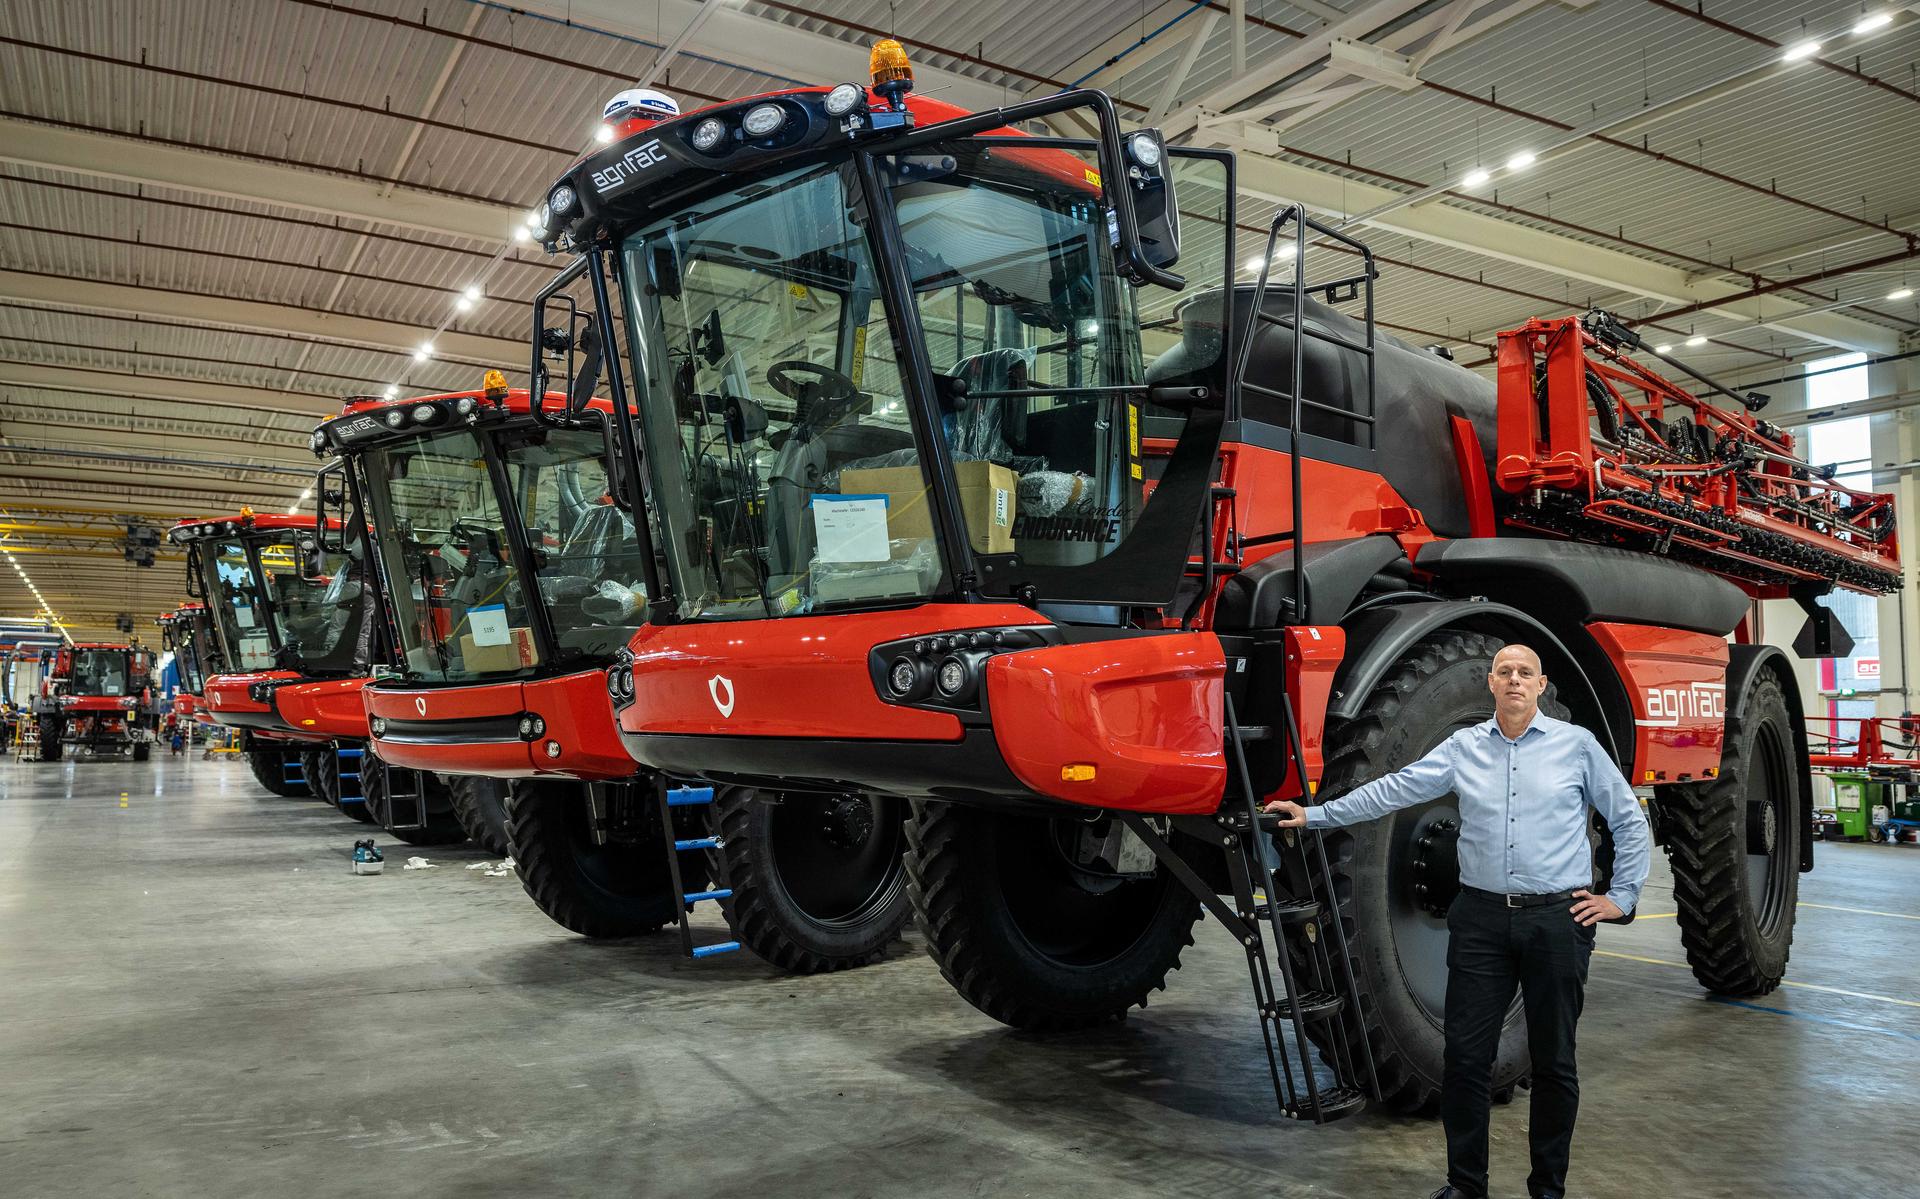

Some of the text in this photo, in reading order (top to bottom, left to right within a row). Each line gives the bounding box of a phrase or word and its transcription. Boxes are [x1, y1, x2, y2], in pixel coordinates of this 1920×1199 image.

[592, 138, 667, 193] agrifac
[336, 416, 376, 438] agrifac
[1010, 515, 1121, 543] ENDURANCE
[1635, 681, 1726, 727] agrifac
